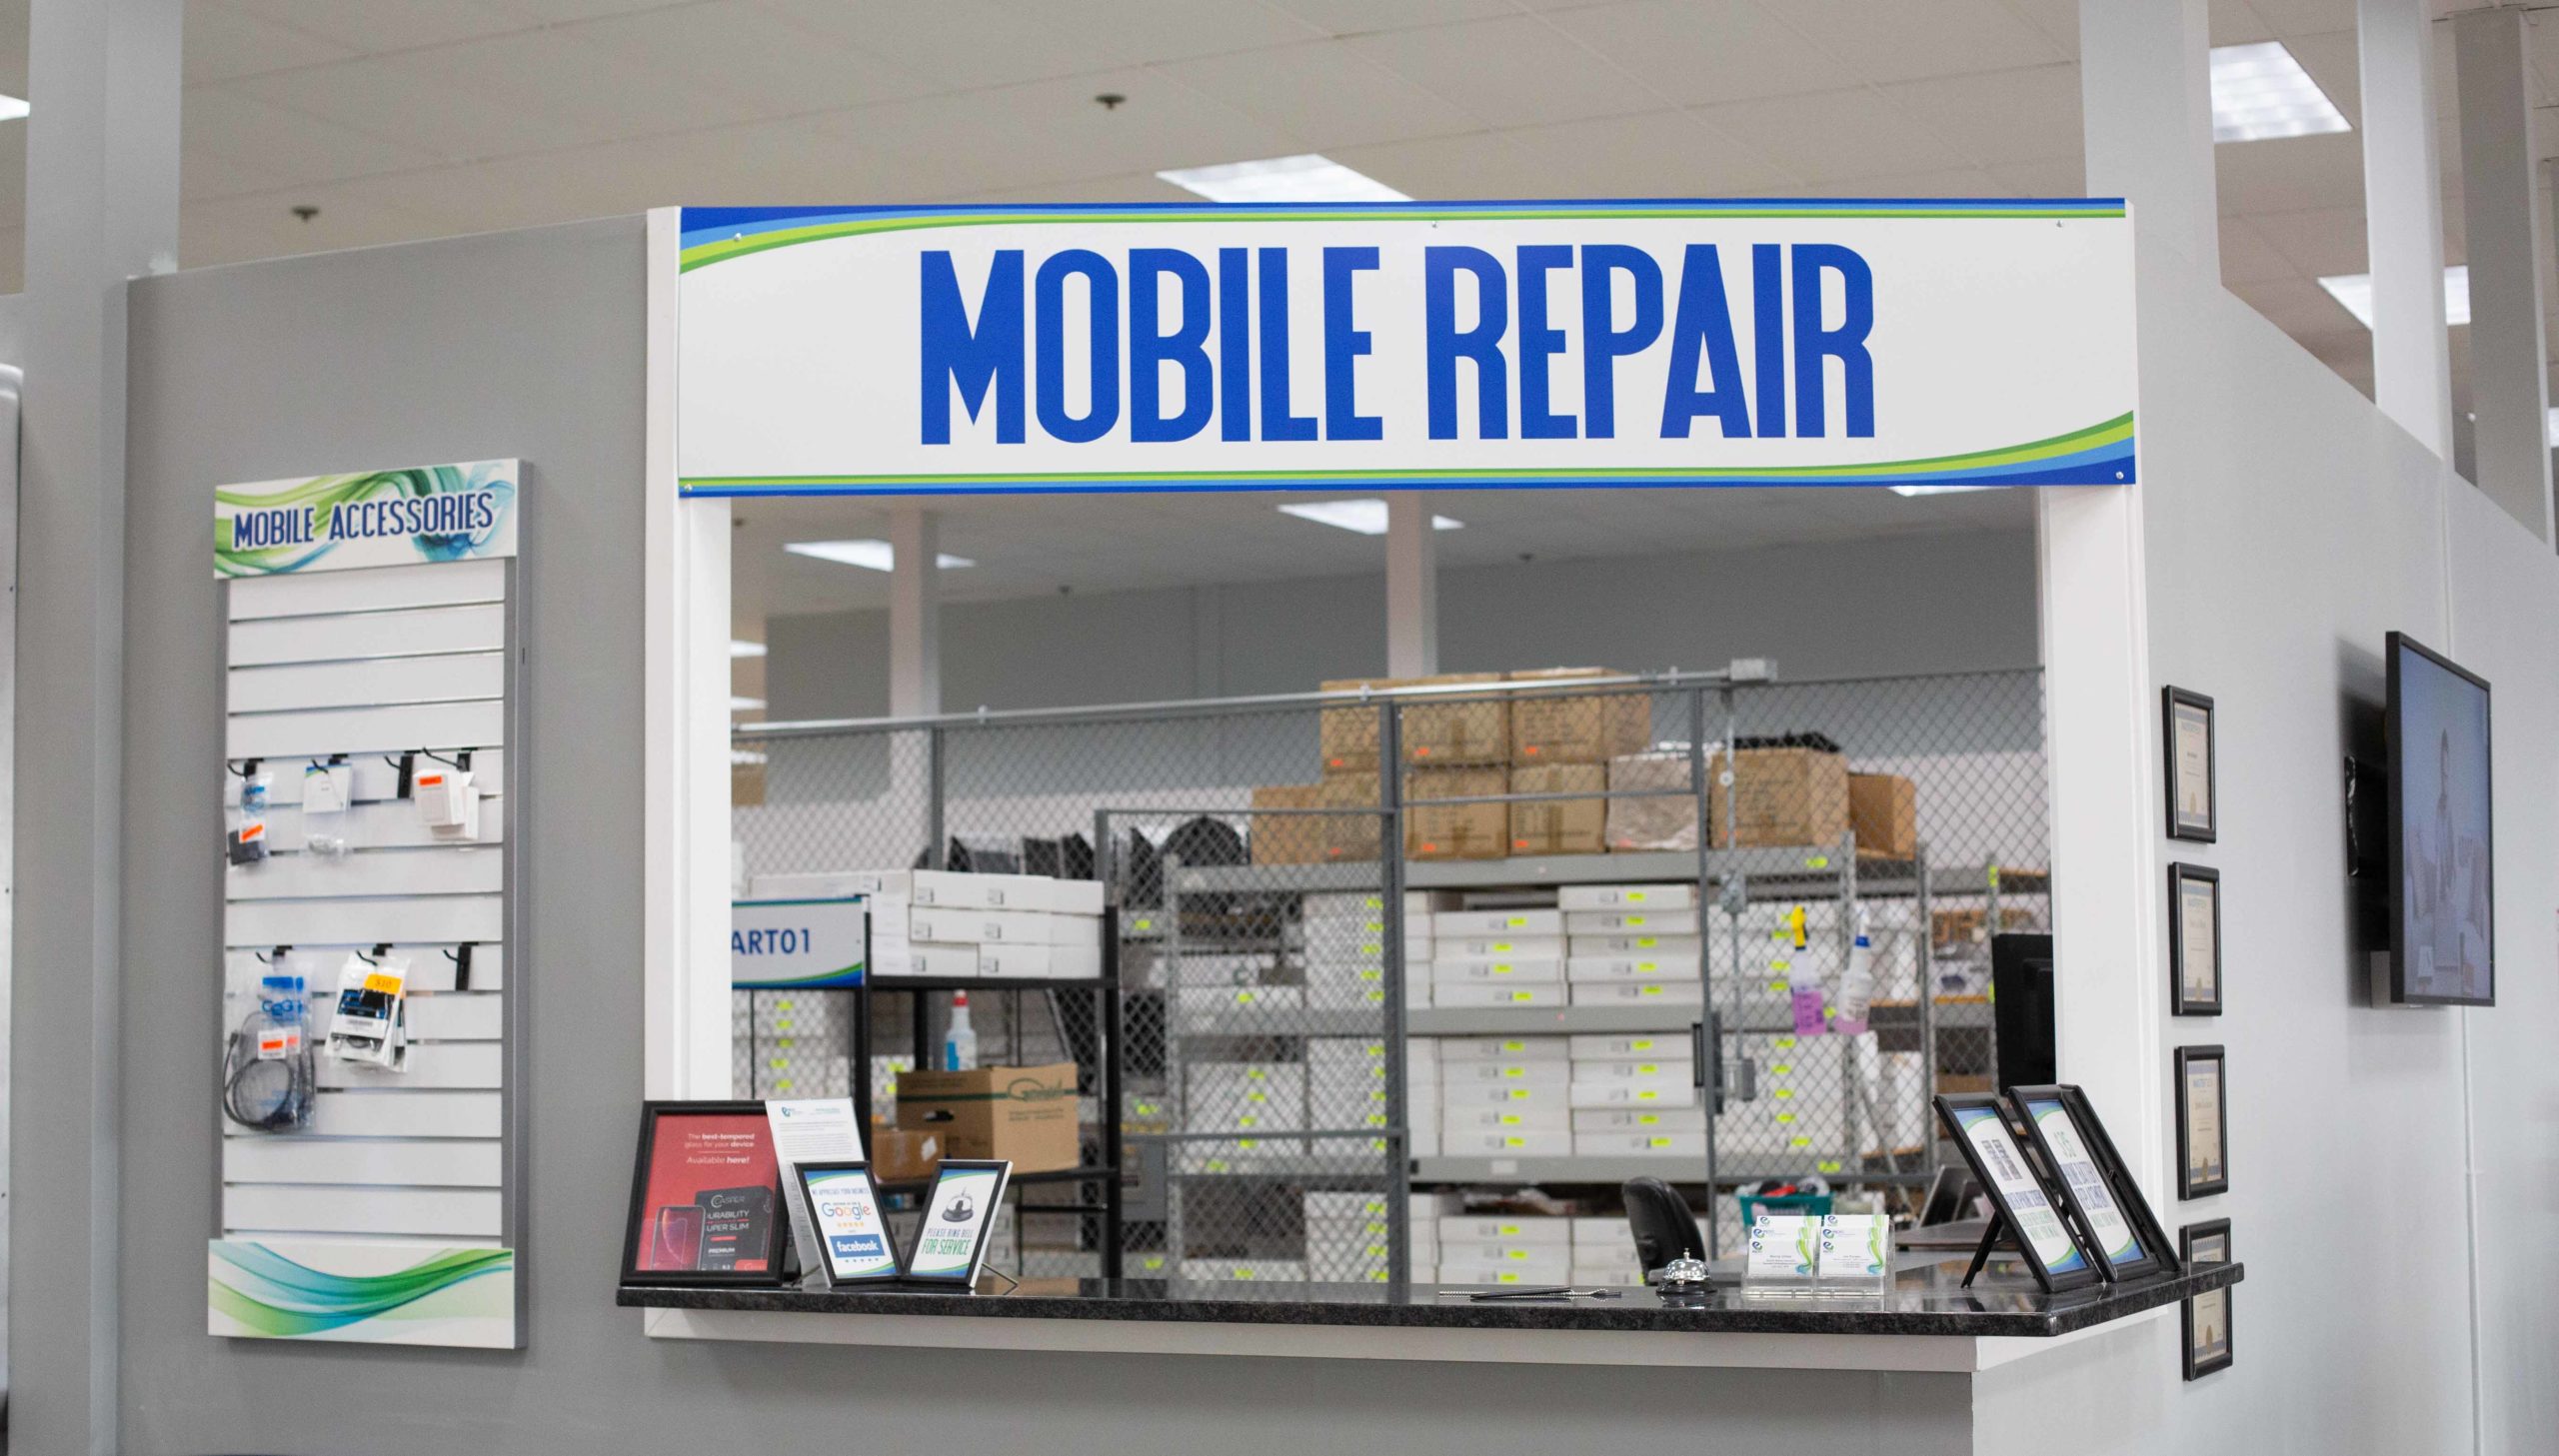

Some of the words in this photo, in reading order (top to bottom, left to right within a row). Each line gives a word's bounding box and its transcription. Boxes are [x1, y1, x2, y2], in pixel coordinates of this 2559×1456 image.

[921, 247, 1383, 445] MOBILE
[1424, 244, 1875, 440] REPAIR
[234, 507, 315, 549] MOBILE
[328, 492, 494, 541] ACCESSORIES
[822, 1202, 872, 1220] Google
[837, 1240, 879, 1252] facebook
[921, 1239, 939, 1255] FOR
[939, 1239, 972, 1255] SERVICE
